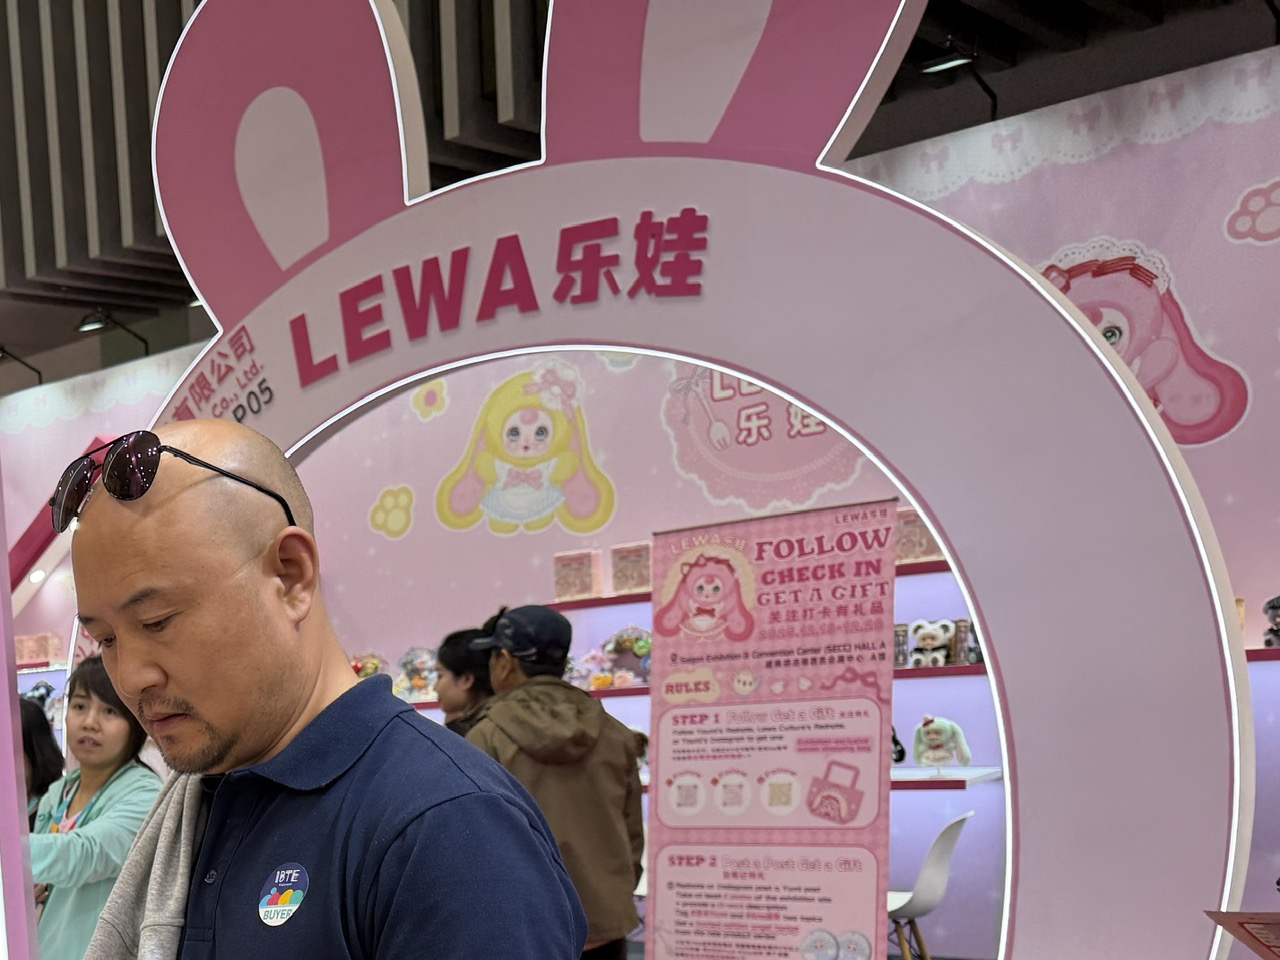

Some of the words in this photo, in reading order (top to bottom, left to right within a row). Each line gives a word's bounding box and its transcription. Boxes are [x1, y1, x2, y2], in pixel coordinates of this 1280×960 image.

[553, 207, 708, 305] 乐娃
[289, 233, 541, 389] LEWA
[171, 325, 255, 422] 有限公司
[754, 527, 892, 562] FOLLOW
[760, 562, 846, 587] CHECK
[853, 558, 882, 577] IN
[756, 588, 803, 607] GET
[809, 587, 824, 603] A
[831, 582, 891, 600] GIFT
[855, 642, 877, 652] HALL
[879, 641, 887, 650] A
[665, 680, 711, 695] RULES
[671, 713, 709, 726] STEP
[713, 712, 720, 725] 1
[668, 855, 705, 867] STEP
[709, 855, 718, 867] 2
[274, 869, 301, 884] IBTE
[262, 908, 293, 920] BUYER
